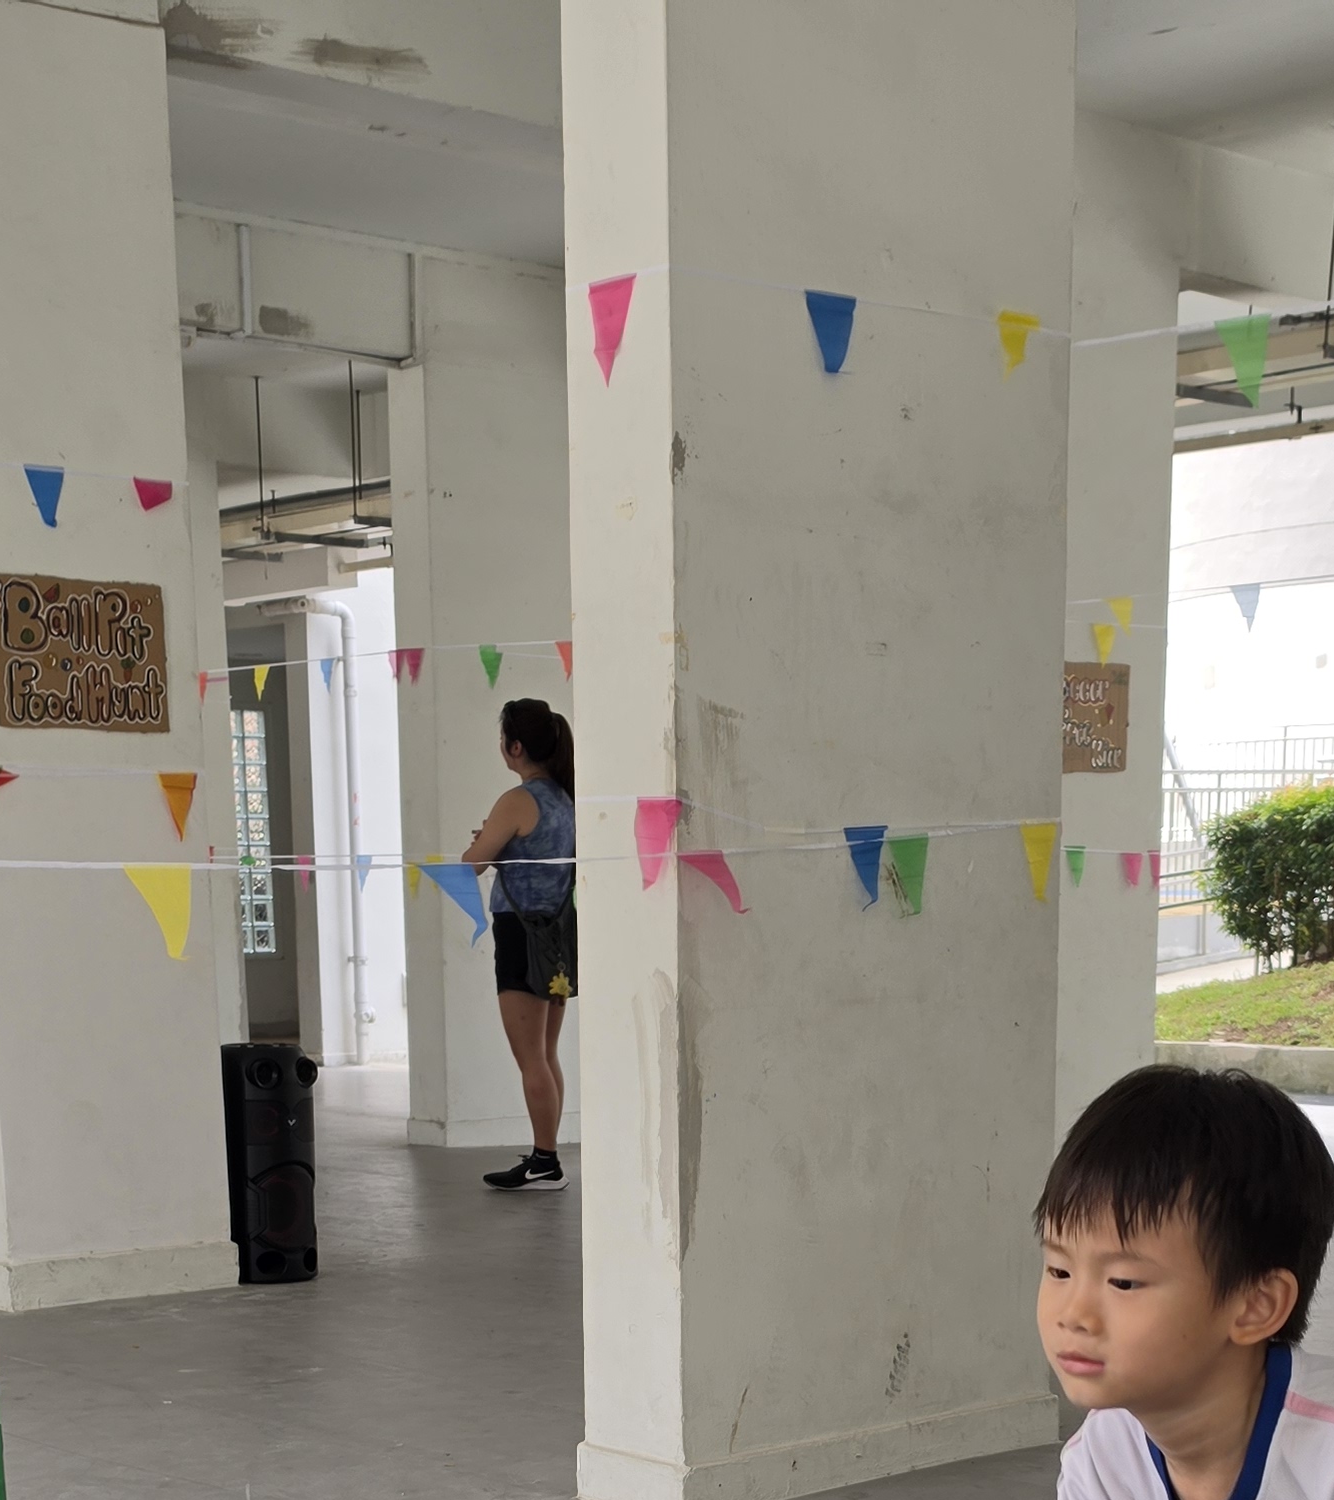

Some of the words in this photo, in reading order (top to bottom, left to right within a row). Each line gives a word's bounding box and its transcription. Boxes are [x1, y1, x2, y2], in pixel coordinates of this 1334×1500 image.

[2, 579, 92, 652] Ball
[94, 589, 152, 662] Pit
[8, 660, 83, 722] Food
[86, 664, 165, 724] Hunt
